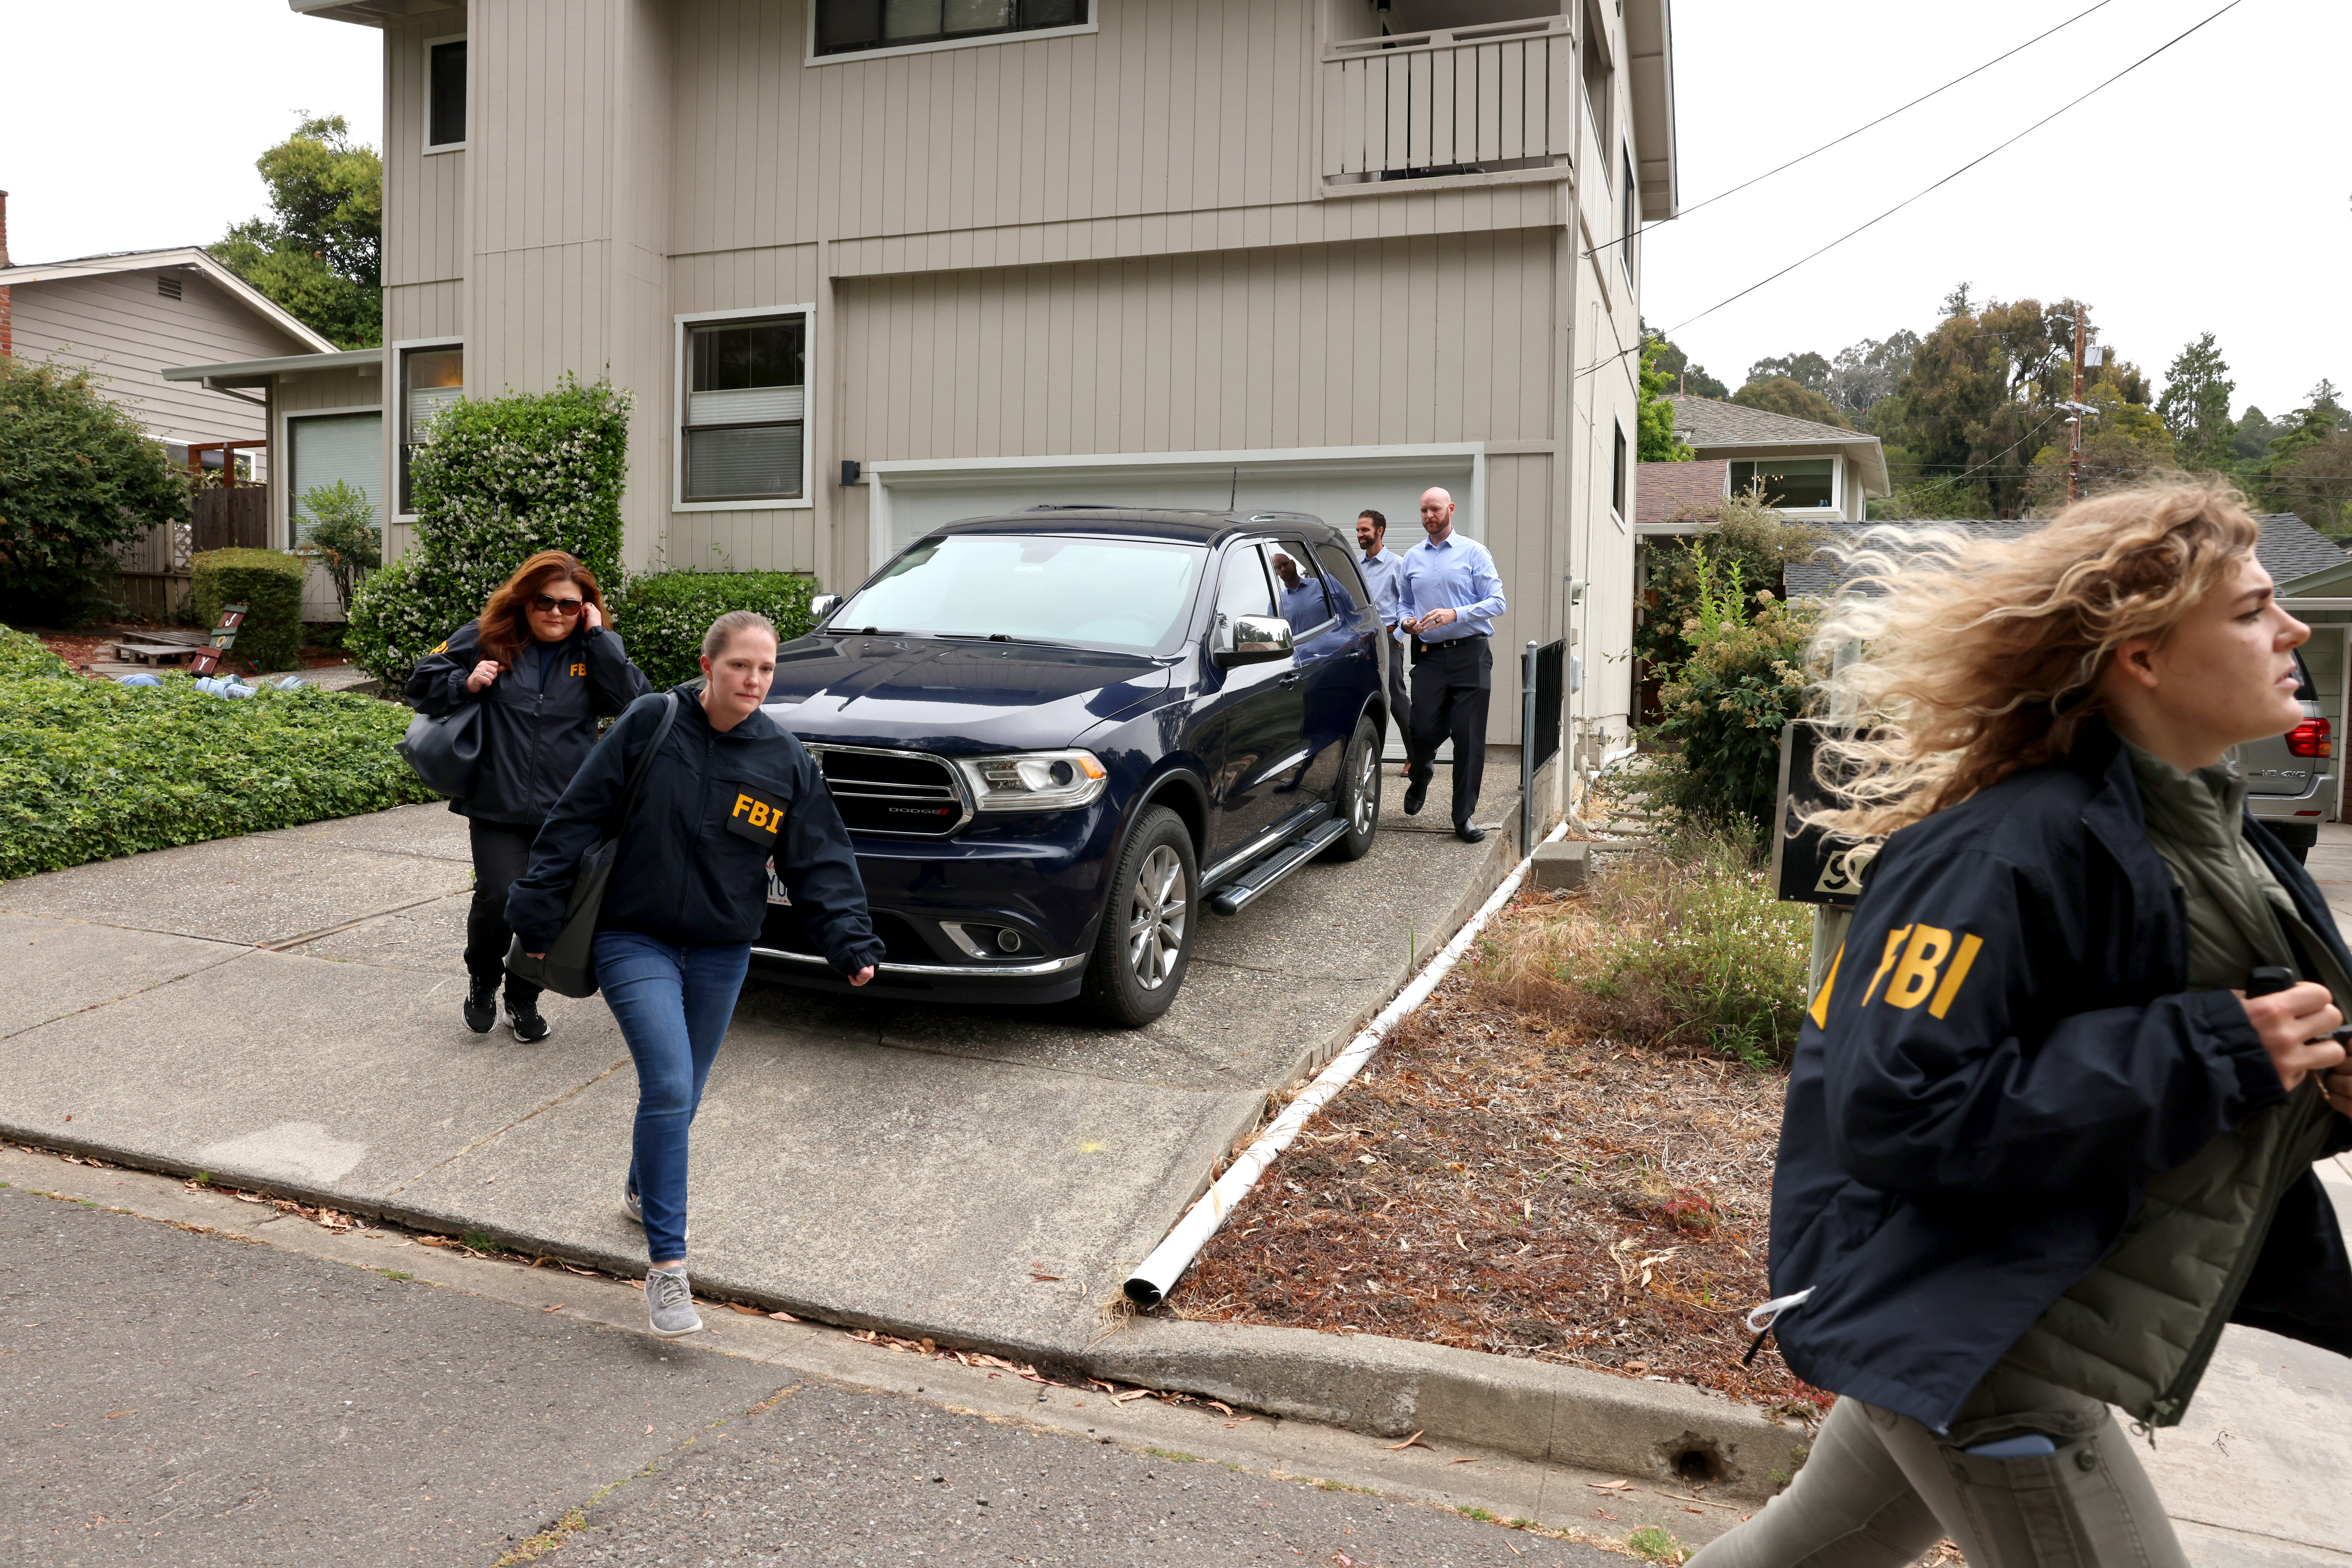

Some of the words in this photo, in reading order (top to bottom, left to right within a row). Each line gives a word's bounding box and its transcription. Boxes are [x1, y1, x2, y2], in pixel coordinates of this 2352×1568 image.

[570, 663, 587, 676] FB
[732, 793, 783, 834] FBI
[1823, 854, 1864, 890] 9
